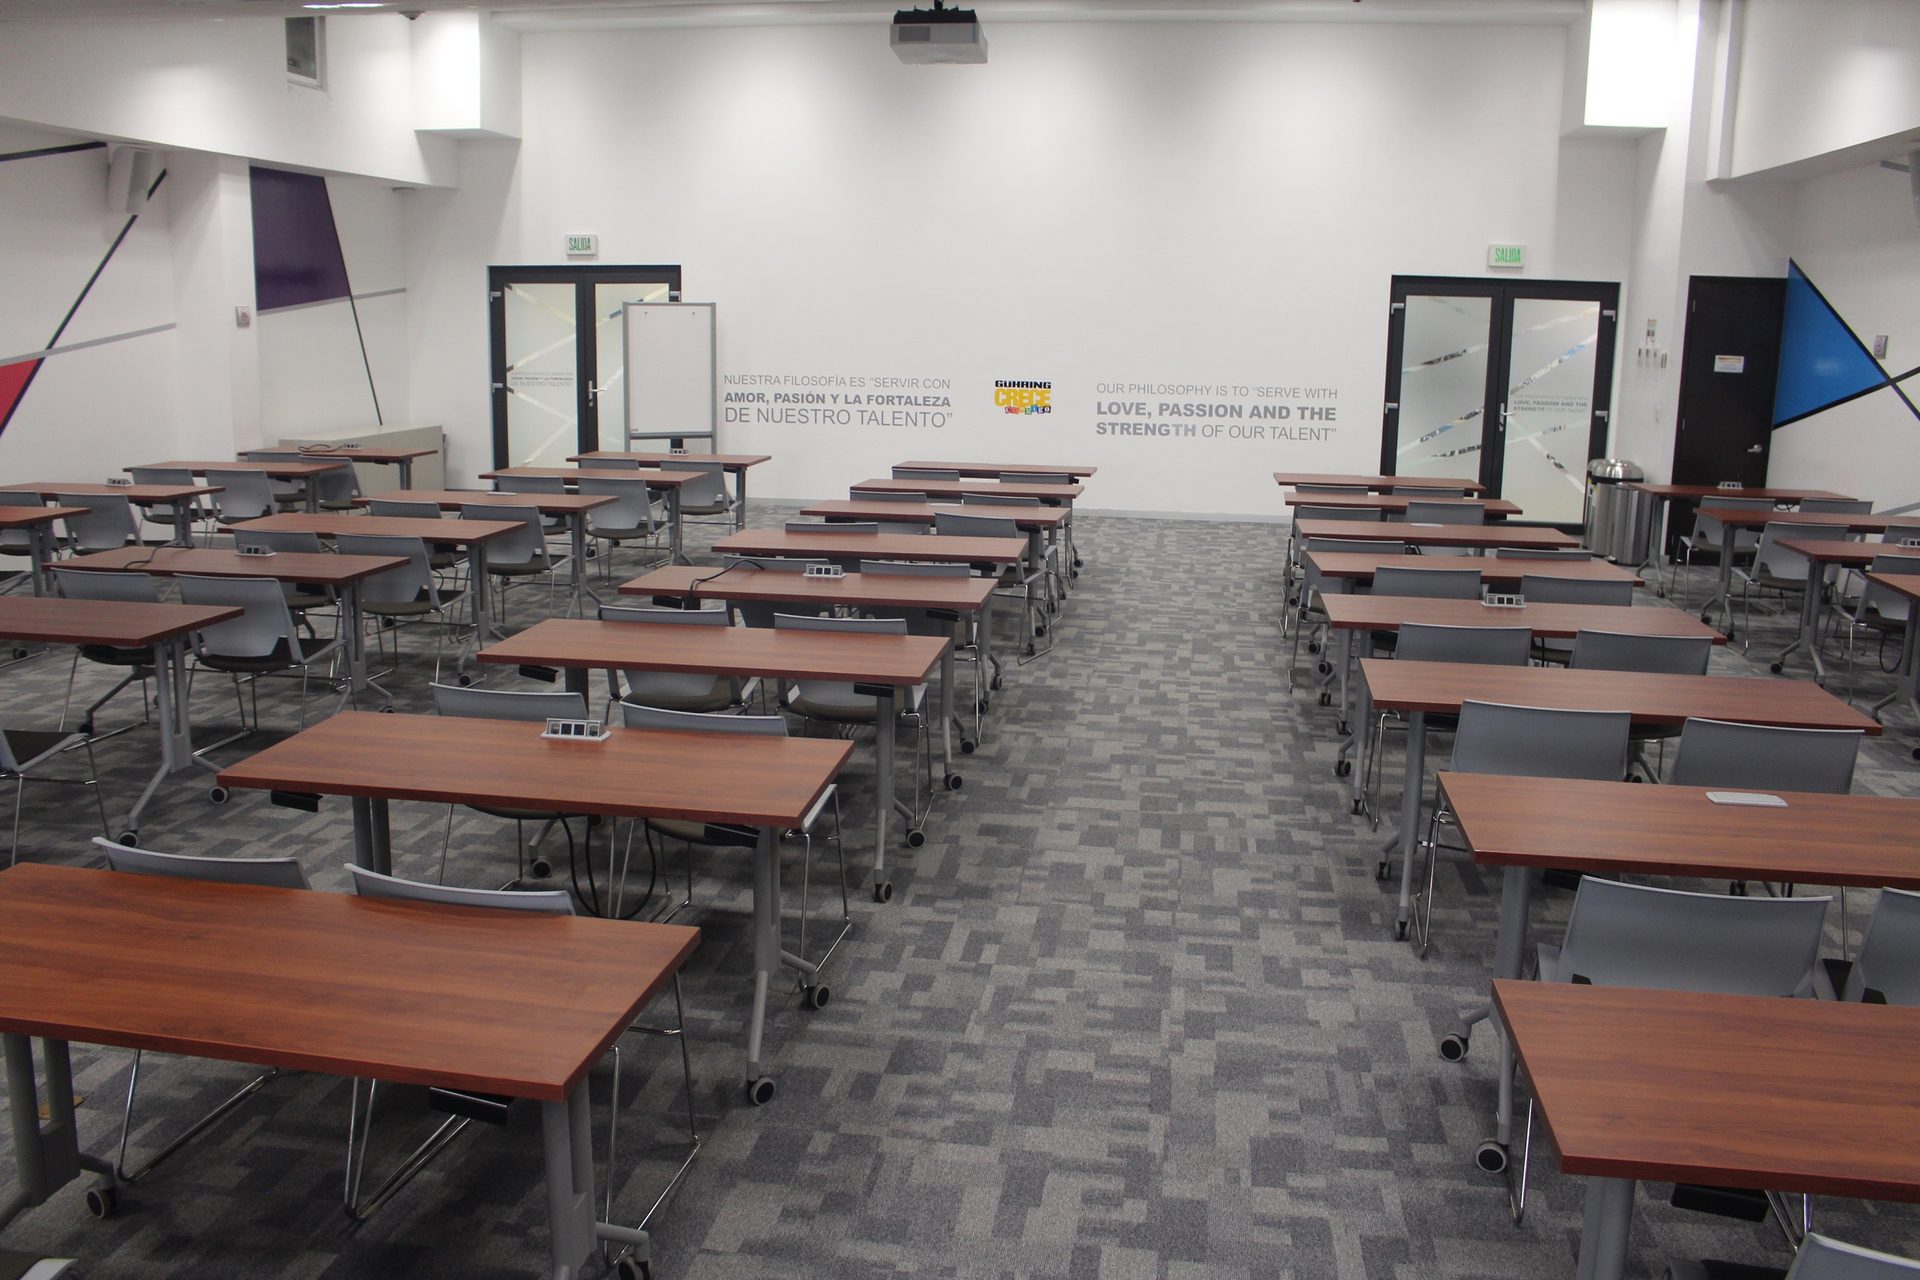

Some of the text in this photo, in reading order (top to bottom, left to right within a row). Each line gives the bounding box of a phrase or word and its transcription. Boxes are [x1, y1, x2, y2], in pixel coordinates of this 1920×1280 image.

[568, 237, 591, 251] SALIDA
[1495, 247, 1521, 263] SALIDA
[723, 374, 780, 385] NUESTRA
[783, 374, 847, 386] FILOSOFÍA
[849, 376, 866, 387] ES
[923, 378, 951, 389] CON
[724, 390, 951, 407] AMOR, PASIÓN Y LA FORTALEZA
[994, 388, 1051, 407] CRECE
[1096, 383, 1124, 394] OUR
[1128, 383, 1213, 396] PHILOSOPHY
[1216, 385, 1228, 396] IS
[1231, 386, 1249, 397] TO
[1304, 388, 1338, 399] WITH
[725, 407, 750, 423] DE
[757, 407, 851, 425] NUESTRO
[1096, 401, 1337, 421] LOVE, PASSION AND THE
[1096, 421, 1196, 437] STRENGTH
[1201, 424, 1224, 438] OF
[1228, 425, 1265, 440] OUR
